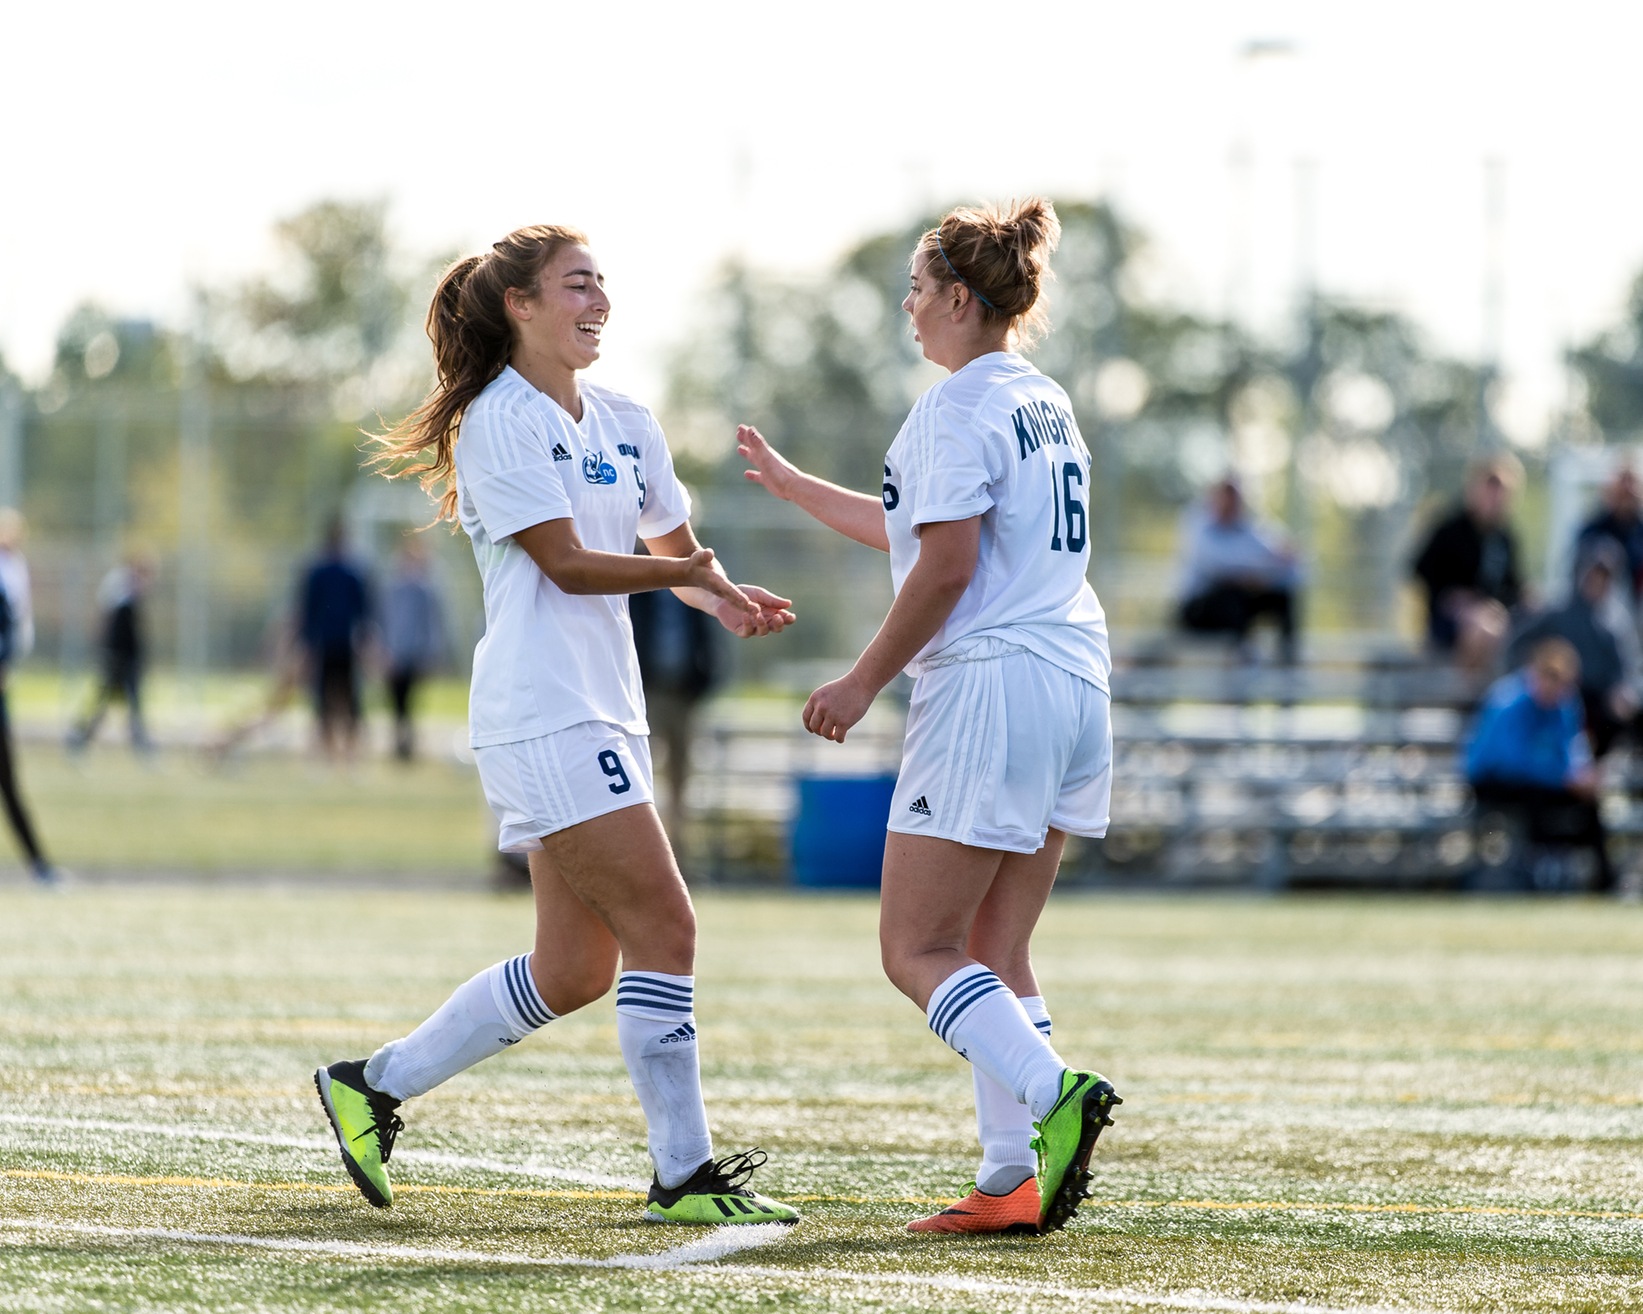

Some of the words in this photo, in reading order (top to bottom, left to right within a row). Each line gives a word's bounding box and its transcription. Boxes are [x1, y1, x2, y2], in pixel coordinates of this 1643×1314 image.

[1011, 400, 1092, 466] KNIGHT
[633, 464, 647, 510] 9
[1051, 460, 1087, 554] 16
[597, 749, 632, 795] 9
[660, 1034, 696, 1044] adida
